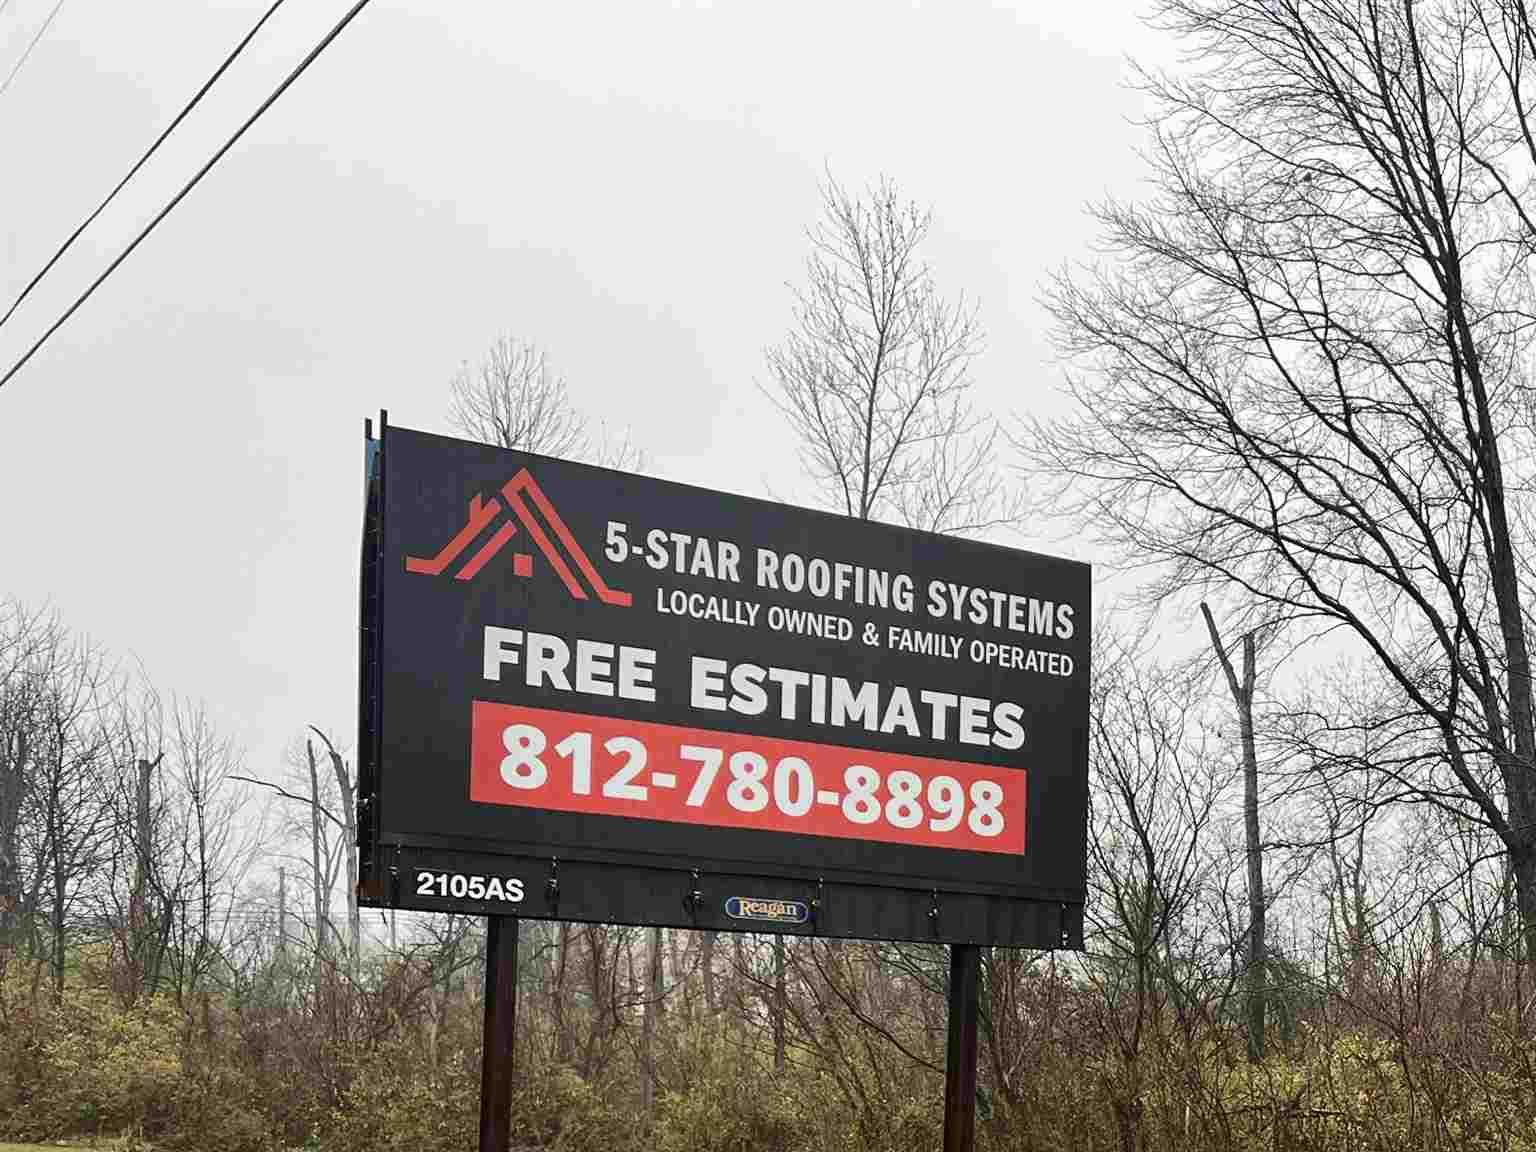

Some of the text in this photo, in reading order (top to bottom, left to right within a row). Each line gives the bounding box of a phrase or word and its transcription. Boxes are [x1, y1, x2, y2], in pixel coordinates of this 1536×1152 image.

[604, 520, 1075, 640] 5-STAR ROOFING SYSTEMS
[656, 587, 1074, 677] LOCALLY OWNED & FAMILY OPERATED
[483, 625, 1025, 750] FREE ESTIMATES
[499, 723, 1005, 837] 812-780-8898
[416, 871, 525, 902] 2105AS
[739, 900, 798, 920] Reagan
